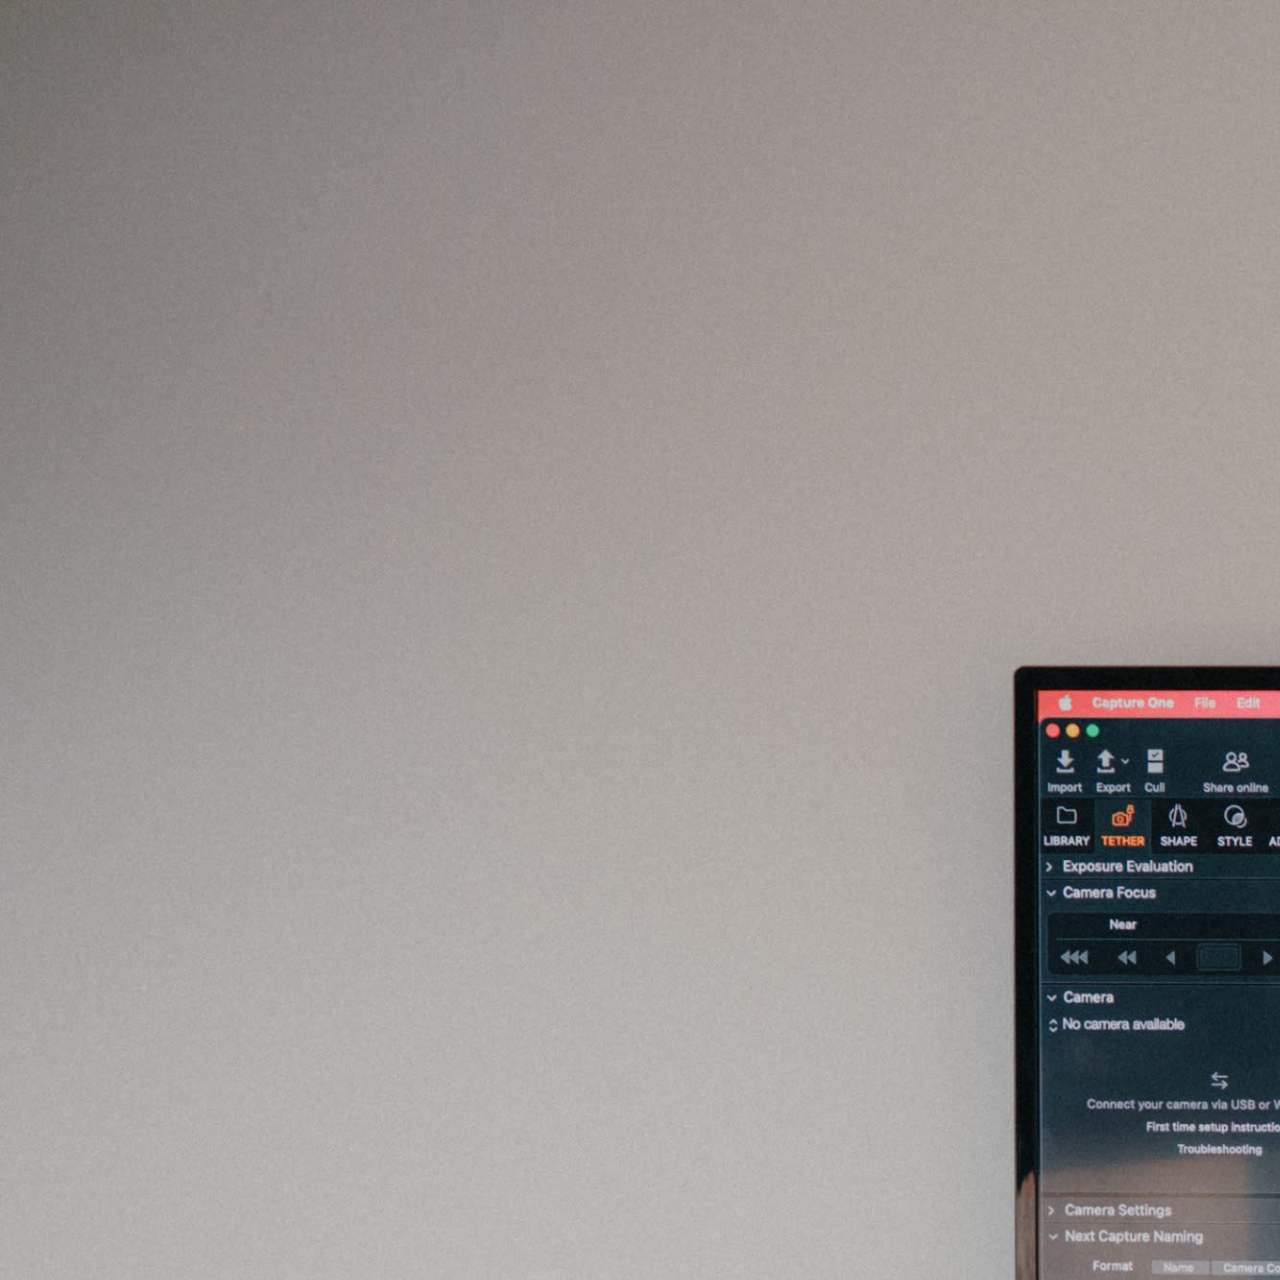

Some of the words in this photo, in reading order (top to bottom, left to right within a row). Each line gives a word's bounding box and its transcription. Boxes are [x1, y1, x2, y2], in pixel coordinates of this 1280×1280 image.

[1092, 697, 1144, 711] Capture
[1147, 697, 1175, 709] One
[1195, 697, 1216, 709] File
[1237, 697, 1260, 709] Edit
[1047, 783, 1083, 794] Import
[1096, 783, 1131, 794] Export
[1144, 782, 1165, 793] Cull
[1203, 783, 1234, 793] Share
[1237, 783, 1269, 793] online
[1043, 835, 1090, 847] LIBRARY
[1101, 835, 1145, 847] TETHER
[1160, 836, 1198, 847] SHAPE
[1217, 836, 1253, 847] STYLE
[1063, 860, 1123, 874] Exposure
[1126, 860, 1194, 873] Evaluation
[1063, 886, 1114, 900] Camera
[1116, 886, 1156, 900] Focus
[1109, 918, 1137, 931] Near
[1063, 990, 1115, 1004] Camera
[1062, 1018, 1081, 1030] No
[1083, 1020, 1130, 1031] camera
[1132, 1017, 1186, 1031] available
[1087, 1099, 1135, 1110] Connect
[1138, 1101, 1163, 1113] your
[1166, 1101, 1208, 1111] camera
[1211, 1099, 1228, 1111] via
[1230, 1099, 1256, 1111] USB
[1258, 1101, 1271, 1111] or
[1146, 1121, 1170, 1133] First
[1172, 1121, 1196, 1133] time
[1198, 1122, 1228, 1135] setup
[1177, 1143, 1263, 1157] Troubleshooting
[1064, 1203, 1115, 1217] Camera
[1118, 1203, 1172, 1219] Settings
[1065, 1230, 1095, 1243] Next
[1098, 1230, 1150, 1246] Capture
[1153, 1230, 1204, 1246] Naming
[1092, 1260, 1134, 1272] Format
[1163, 1263, 1195, 1273] Name
[1223, 1263, 1264, 1274] Camera
